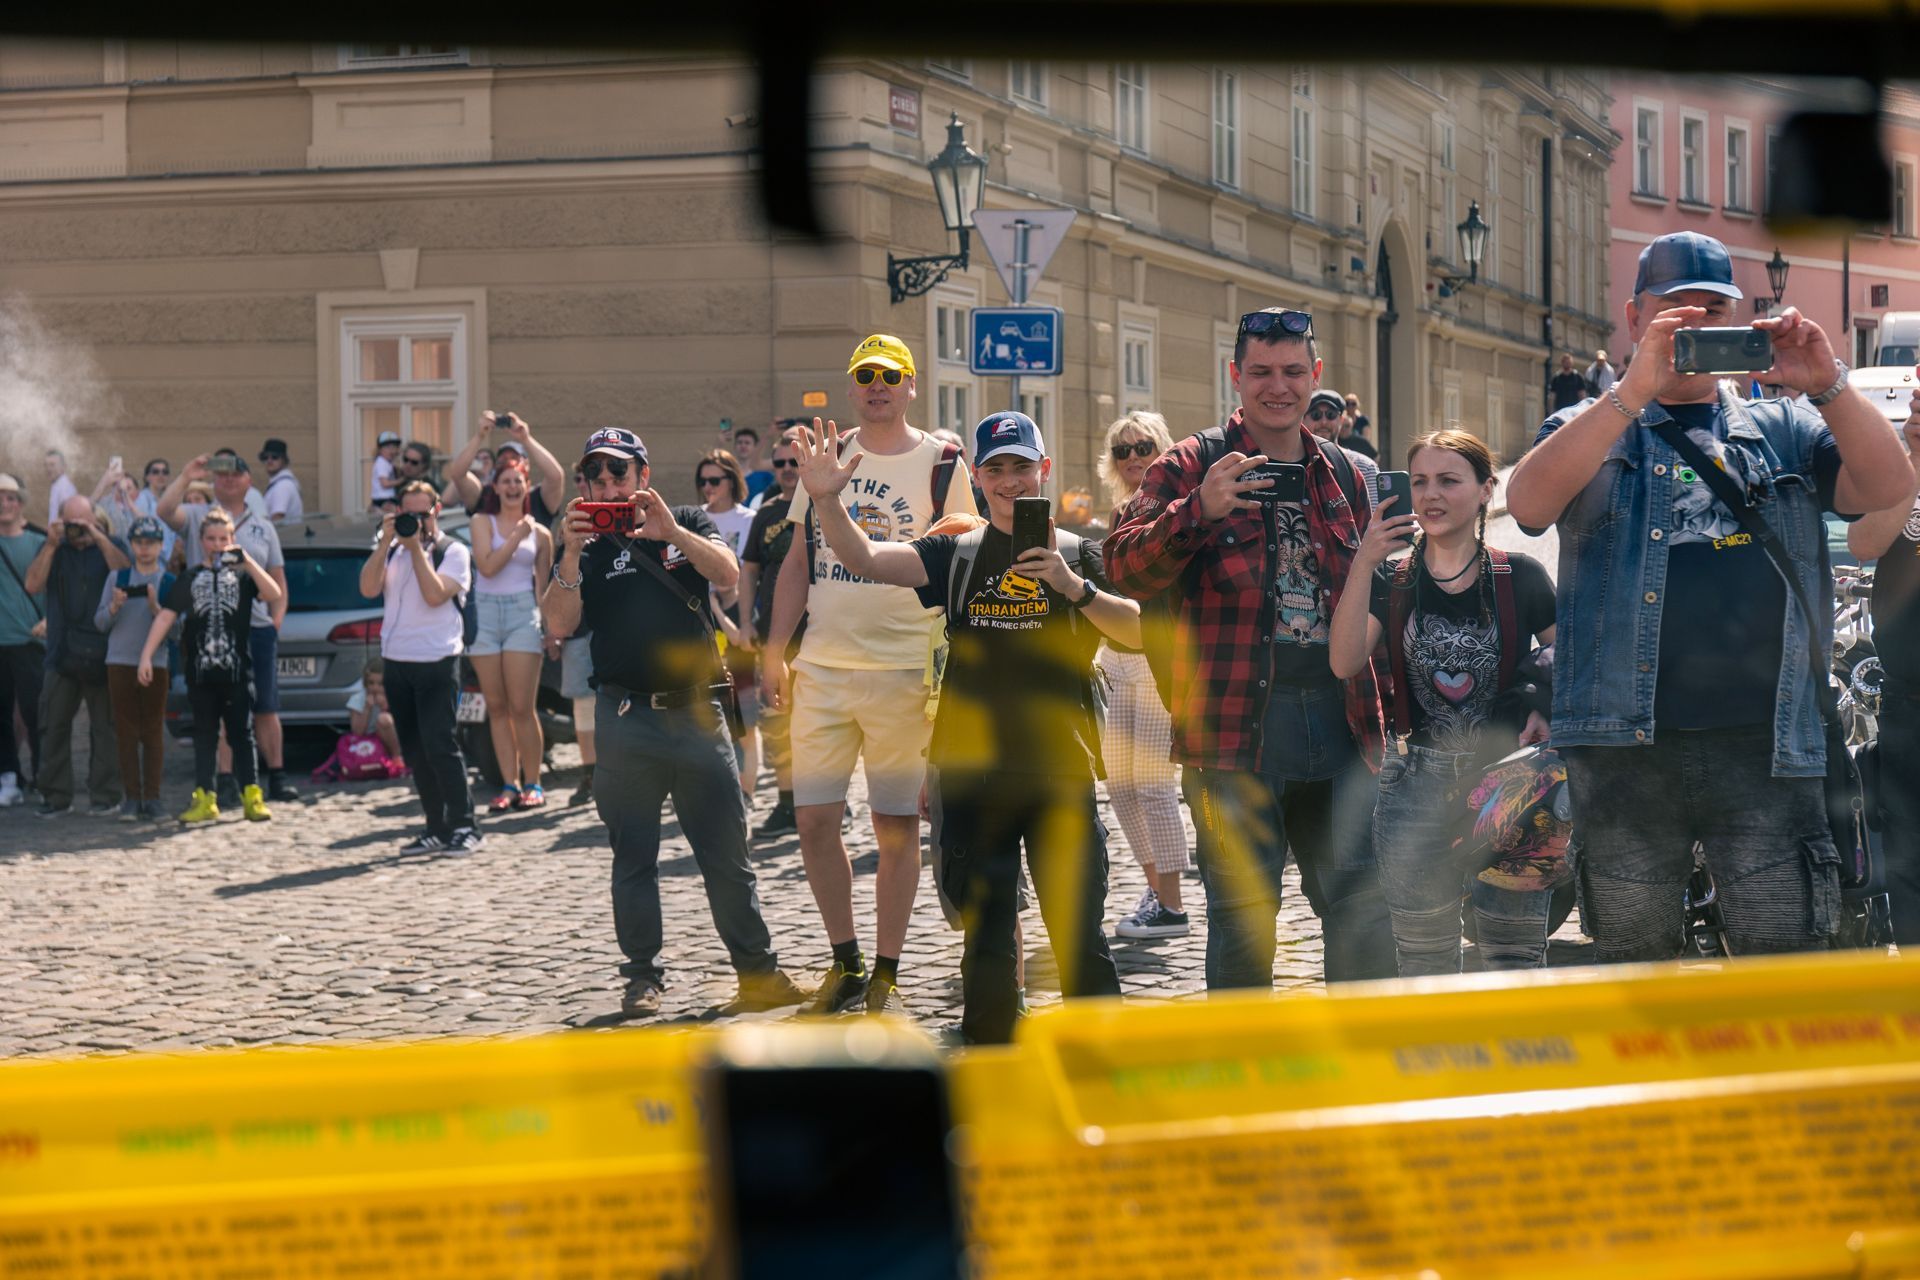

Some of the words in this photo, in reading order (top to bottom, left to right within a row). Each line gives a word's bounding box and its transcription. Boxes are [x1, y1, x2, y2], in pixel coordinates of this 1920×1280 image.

[861, 340, 887, 350] LCL
[850, 478, 891, 499] THE
[890, 496, 916, 543] WAV
[969, 601, 1047, 617] TRABANTEM
[980, 619, 990, 627] NA
[991, 620, 1019, 630] KONEC
[1019, 620, 1042, 630] SVĚTA
[1440, 652, 1470, 671] Bike
